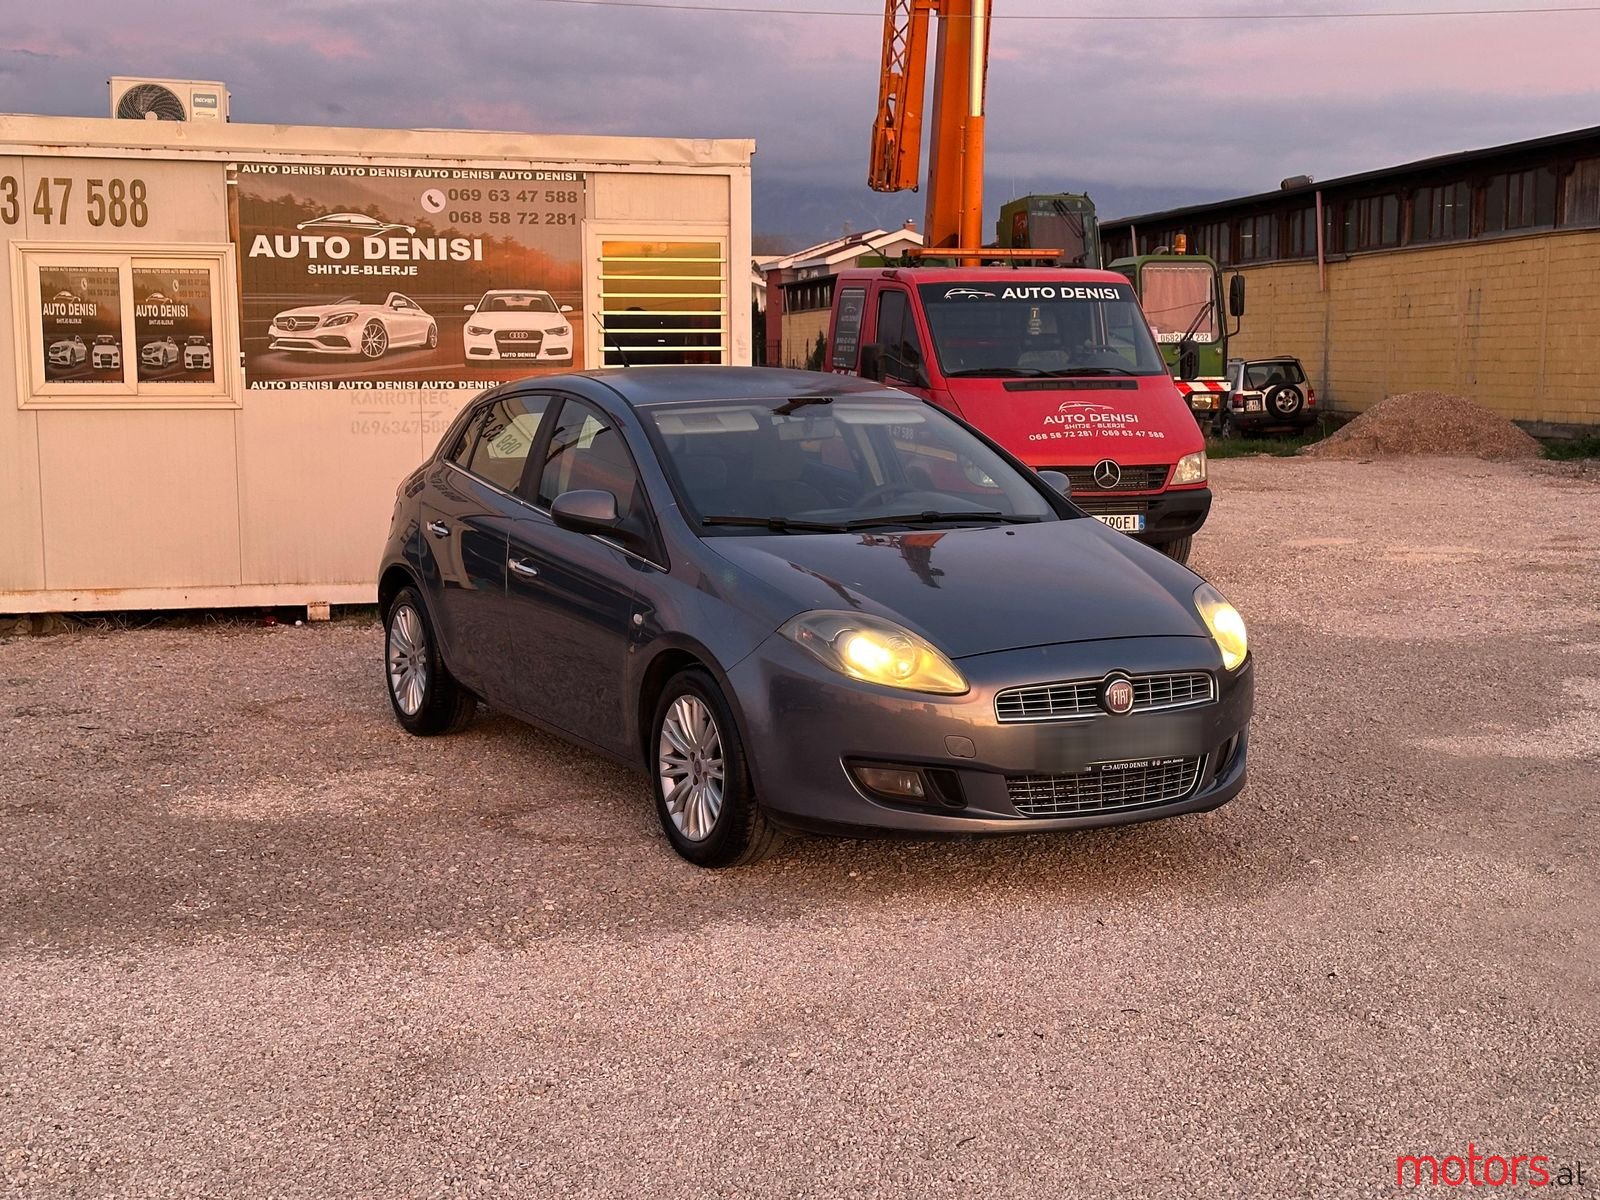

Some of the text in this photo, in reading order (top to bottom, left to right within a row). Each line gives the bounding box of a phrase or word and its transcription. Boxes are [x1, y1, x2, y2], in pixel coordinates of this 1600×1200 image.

[242, 164, 577, 181] AUTO DENISI AUTO DENISI AUTO DENISI AUTO DENISI
[33, 177, 73, 225] 47
[87, 178, 149, 228] 588
[448, 188, 578, 203] 069 63 47 588
[449, 211, 577, 225] 068 58 72 281
[248, 234, 483, 261] AUTO DENISI
[307, 264, 418, 276] SHITJE-BLERJE
[1001, 287, 1120, 300] AUTO DENISI
[42, 303, 97, 316] AUTO DENISI
[135, 304, 189, 318] AUTO DENISI
[250, 381, 286, 390] AUTO
[290, 381, 333, 390] DENISI
[338, 381, 372, 390] AUTO
[376, 381, 418, 390] DENISI
[421, 381, 455, 390] AUTO
[1043, 413, 1139, 425] AUTO DENISI
[1113, 689, 1129, 705] FIAT
[1129, 761, 1149, 769] DENISI
